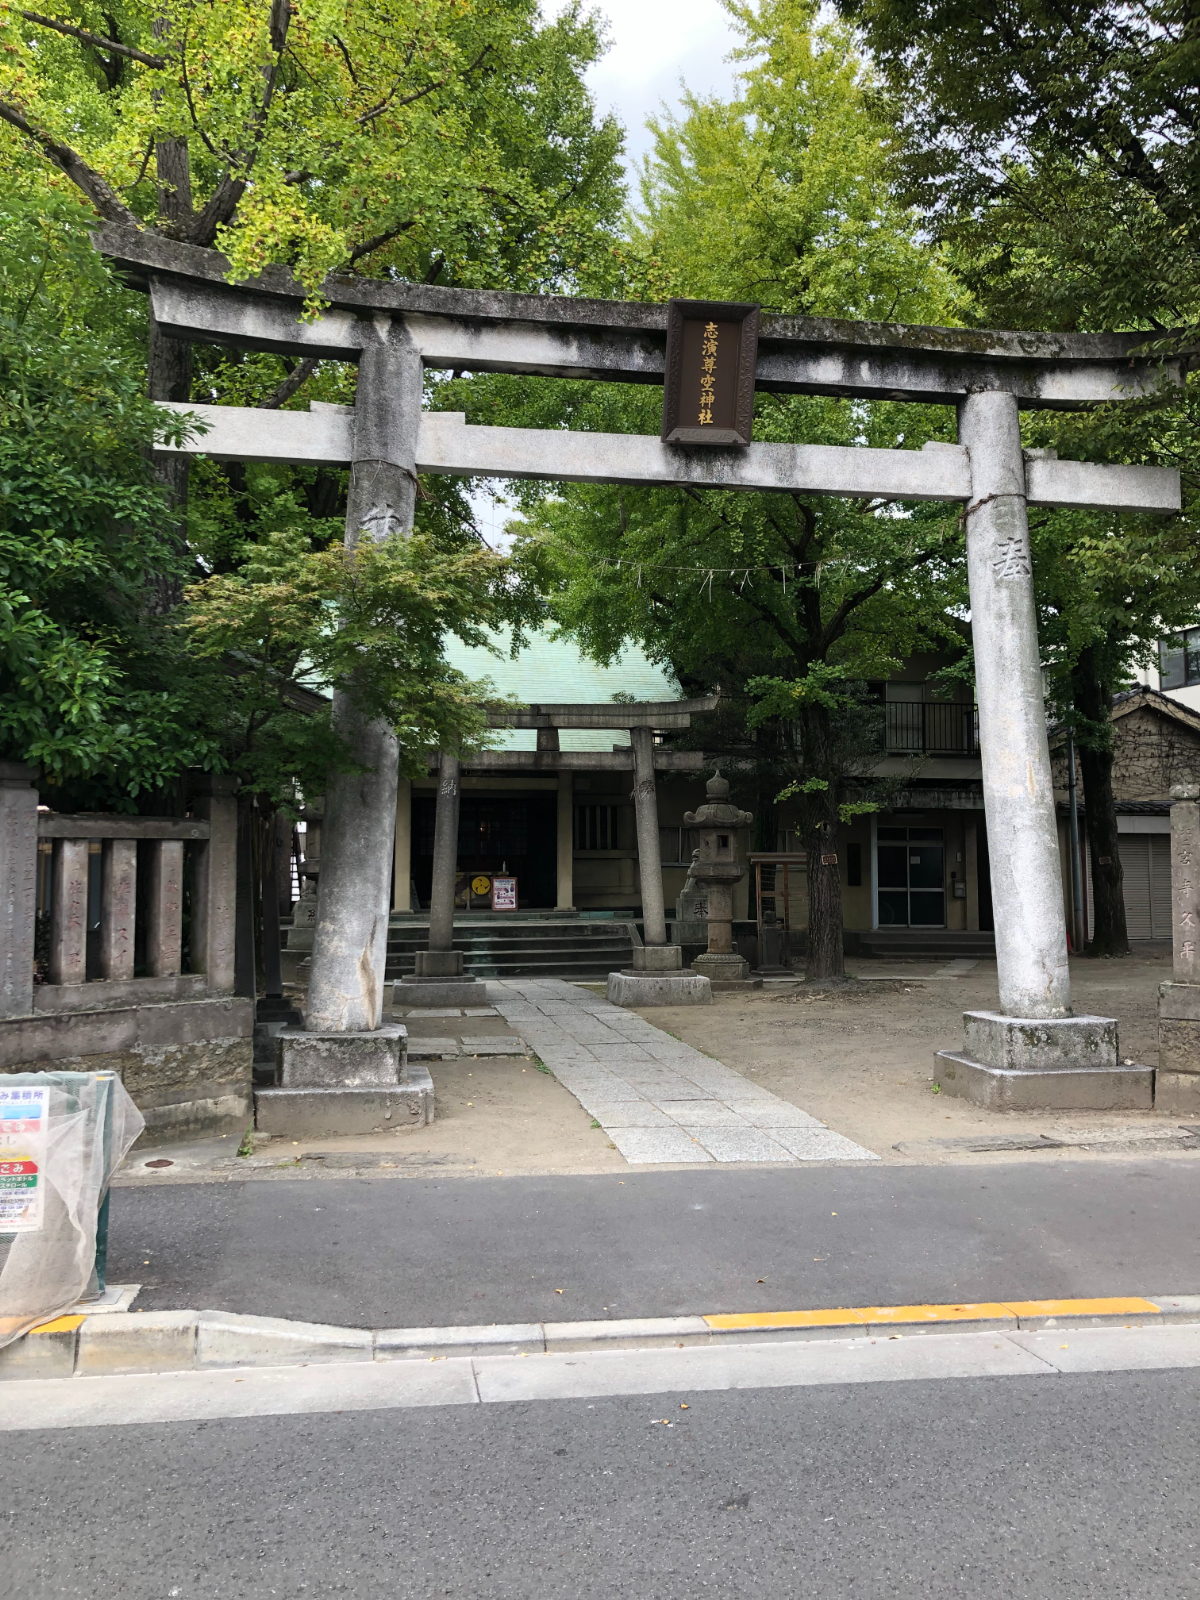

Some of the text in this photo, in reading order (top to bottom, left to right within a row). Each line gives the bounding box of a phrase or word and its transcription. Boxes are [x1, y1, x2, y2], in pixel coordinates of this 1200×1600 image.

[697, 321, 719, 426] 志演尊空神社
[0, 1163, 24, 1174] ごみ
